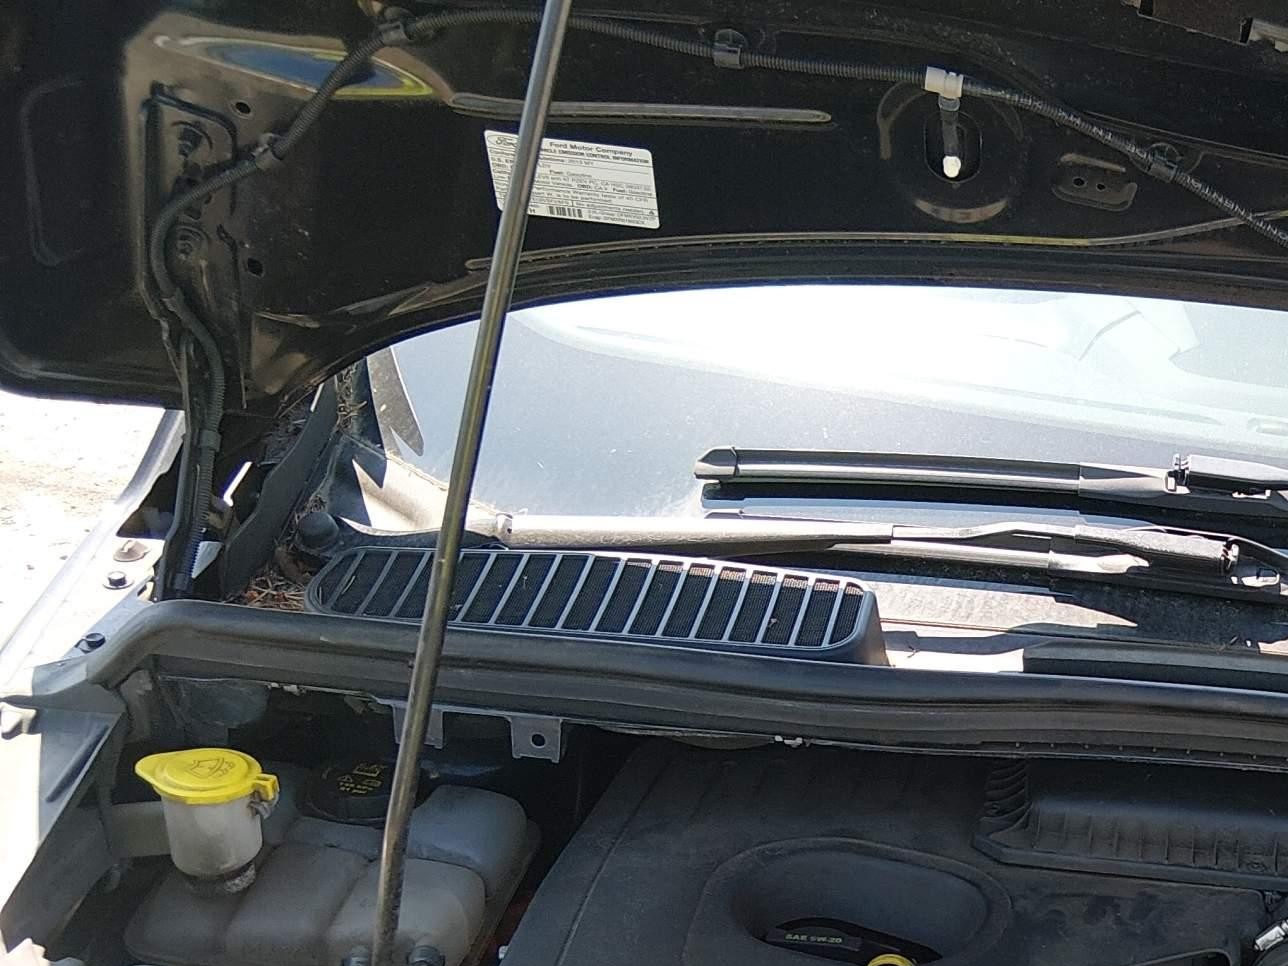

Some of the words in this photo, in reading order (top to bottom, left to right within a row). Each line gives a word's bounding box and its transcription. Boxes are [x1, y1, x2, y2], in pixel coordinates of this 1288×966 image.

[549, 141, 568, 149] Ford
[569, 143, 593, 151] Motor
[595, 146, 633, 157] Company
[785, 933, 808, 941] SAE
